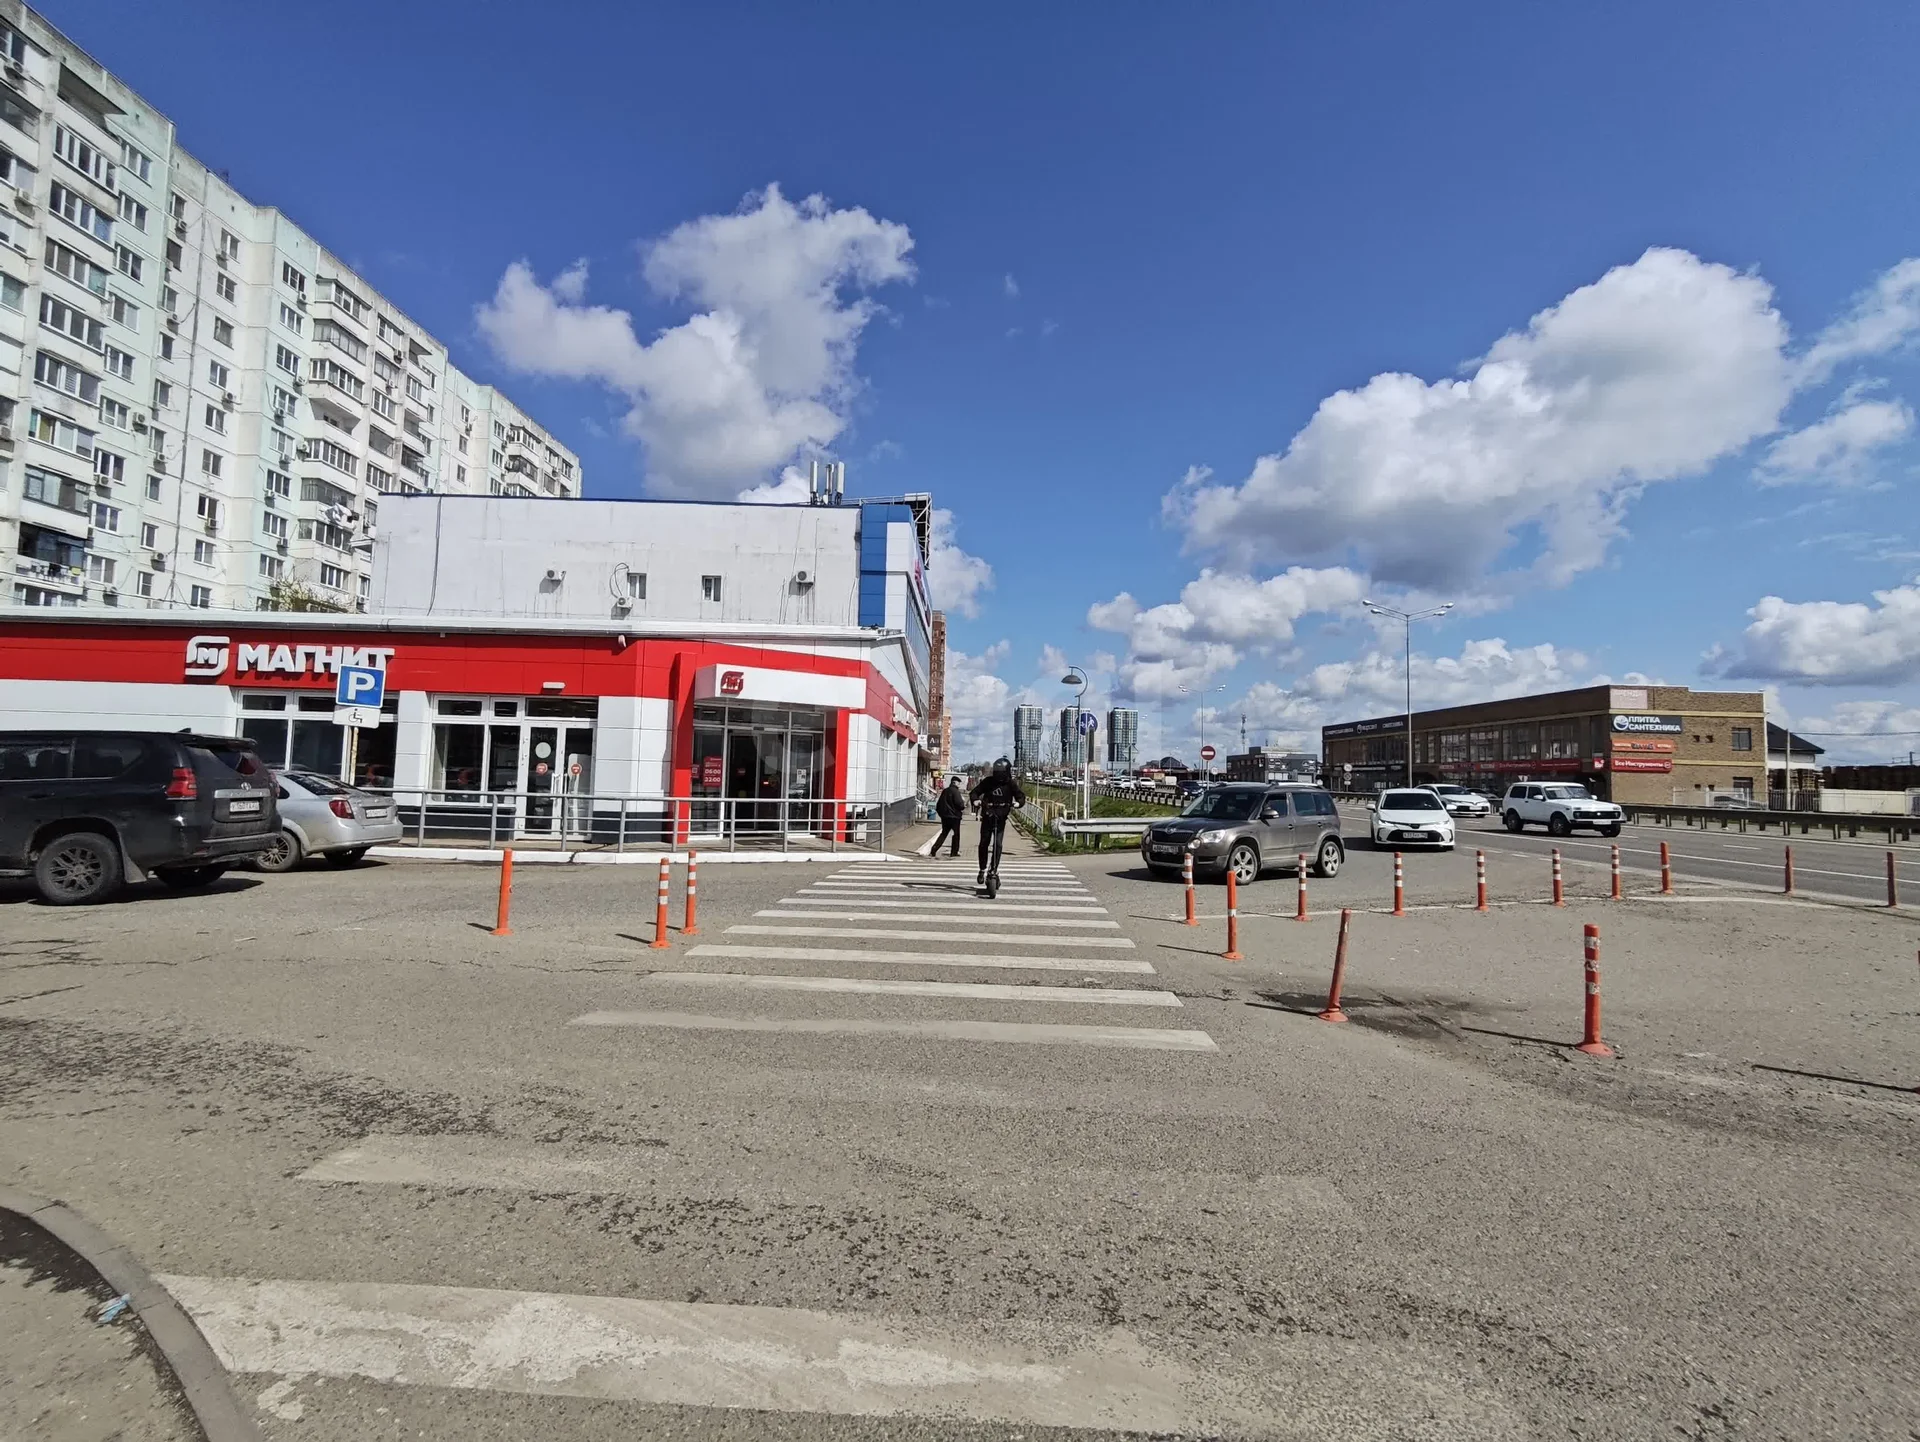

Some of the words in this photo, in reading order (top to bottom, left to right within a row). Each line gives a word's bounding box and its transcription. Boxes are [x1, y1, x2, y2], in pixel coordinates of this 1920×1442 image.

[237, 643, 395, 674] МАГНИТ
[1628, 723, 1681, 731] САНТЕХНИКА
[1625, 760, 1664, 768] Инструменты
